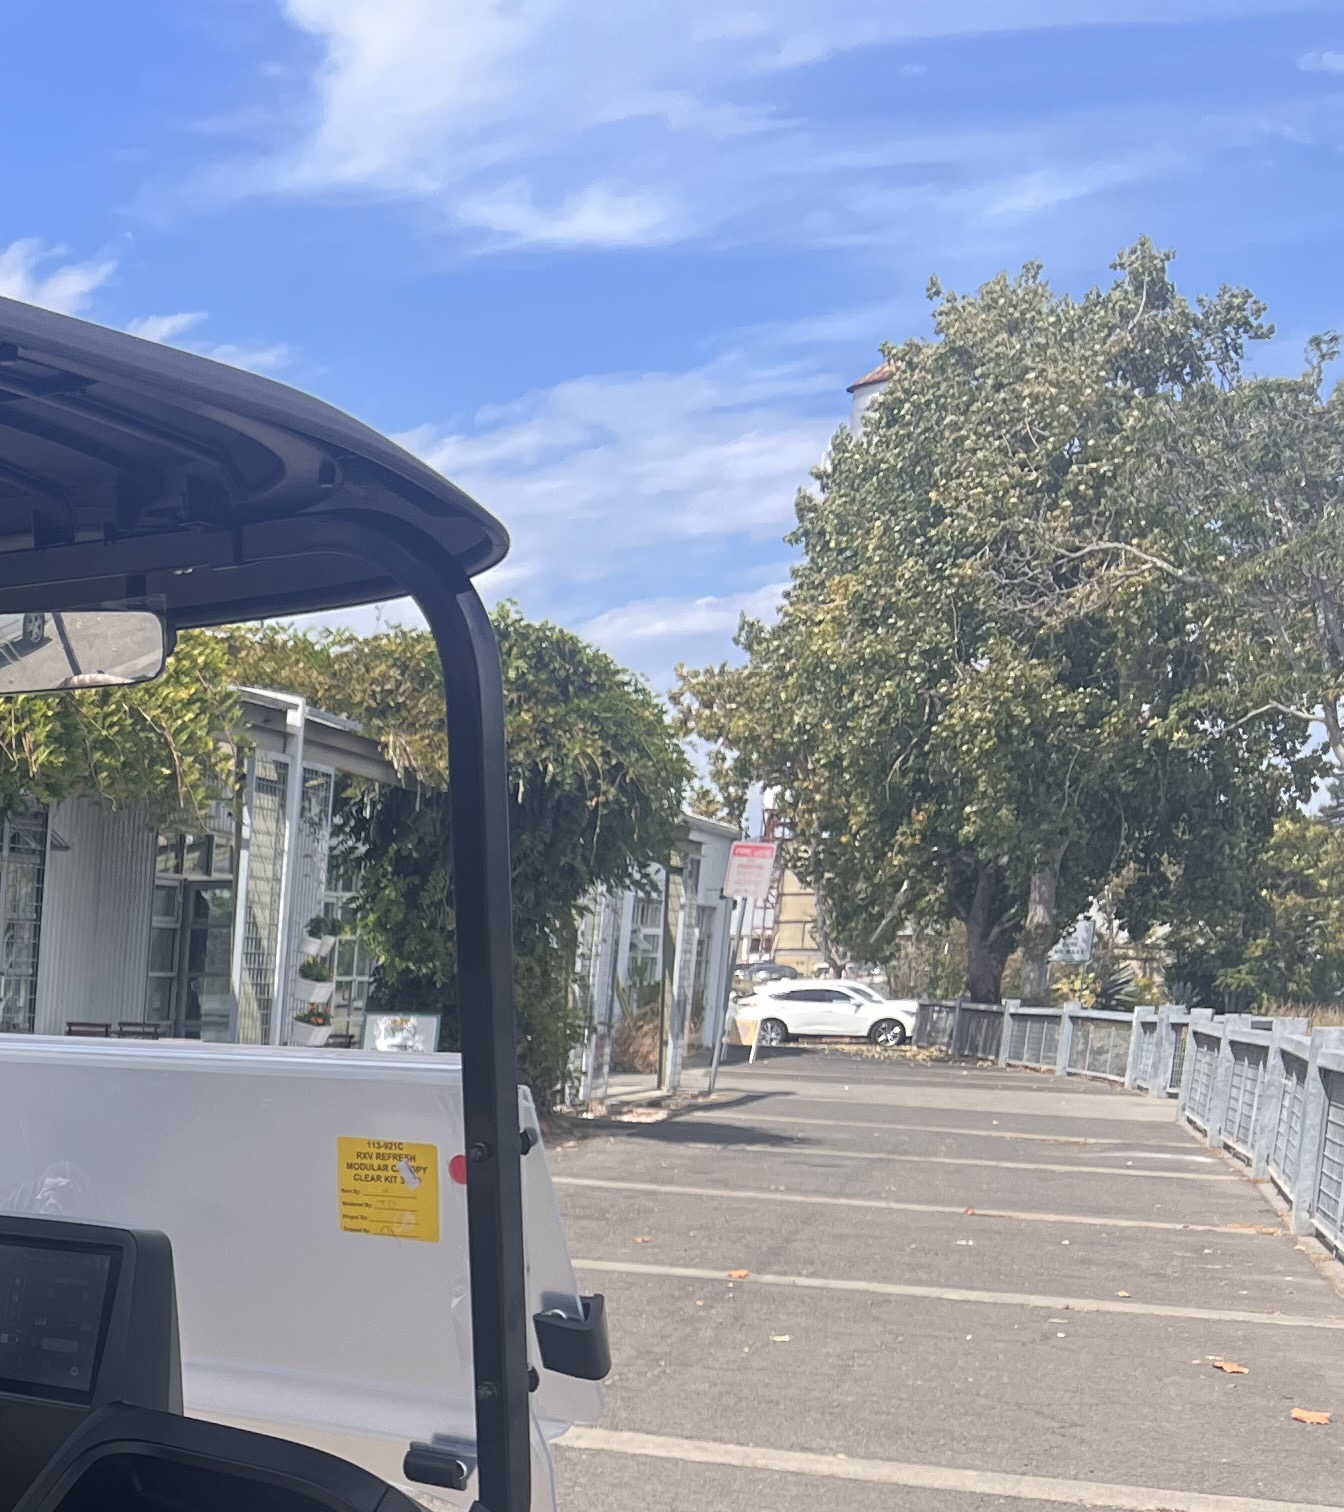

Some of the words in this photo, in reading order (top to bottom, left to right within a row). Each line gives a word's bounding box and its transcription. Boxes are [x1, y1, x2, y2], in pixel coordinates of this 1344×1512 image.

[356, 1152, 373, 1160] RXV
[375, 1153, 416, 1163] REFRESH
[346, 1162, 389, 1172] MODULAR
[353, 1174, 382, 1183] CLEAR
[384, 1175, 398, 1184] KIT
